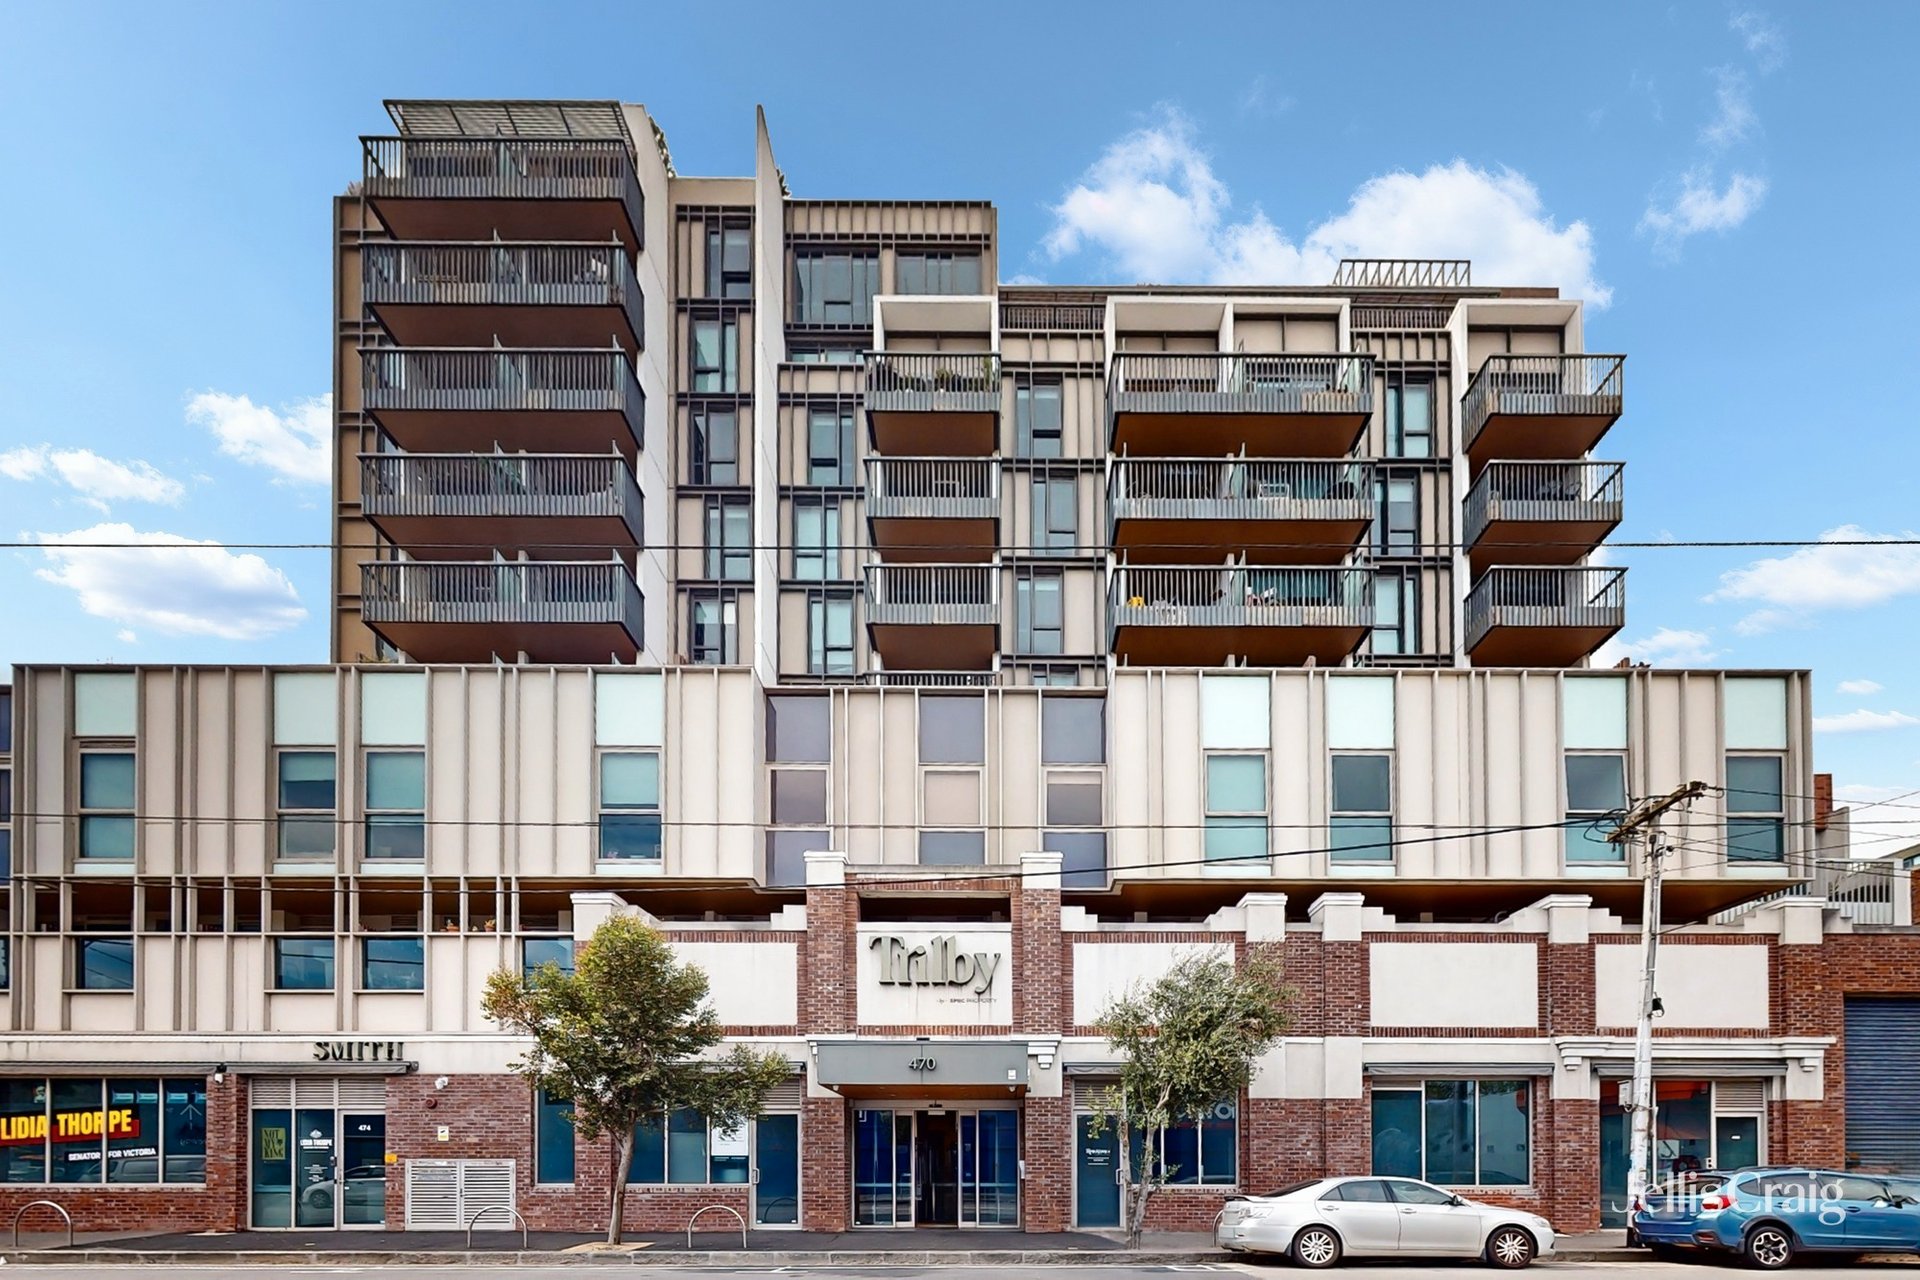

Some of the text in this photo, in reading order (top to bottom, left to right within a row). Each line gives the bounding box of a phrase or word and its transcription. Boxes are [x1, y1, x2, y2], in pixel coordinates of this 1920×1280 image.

[869, 935, 1001, 994] Trilby
[312, 1041, 405, 1061] SMITH
[908, 1057, 937, 1070] 470
[0, 1109, 132, 1140] LIDIA THORPE
[68, 1147, 156, 1161] SENATOR FOR VICTORIA
